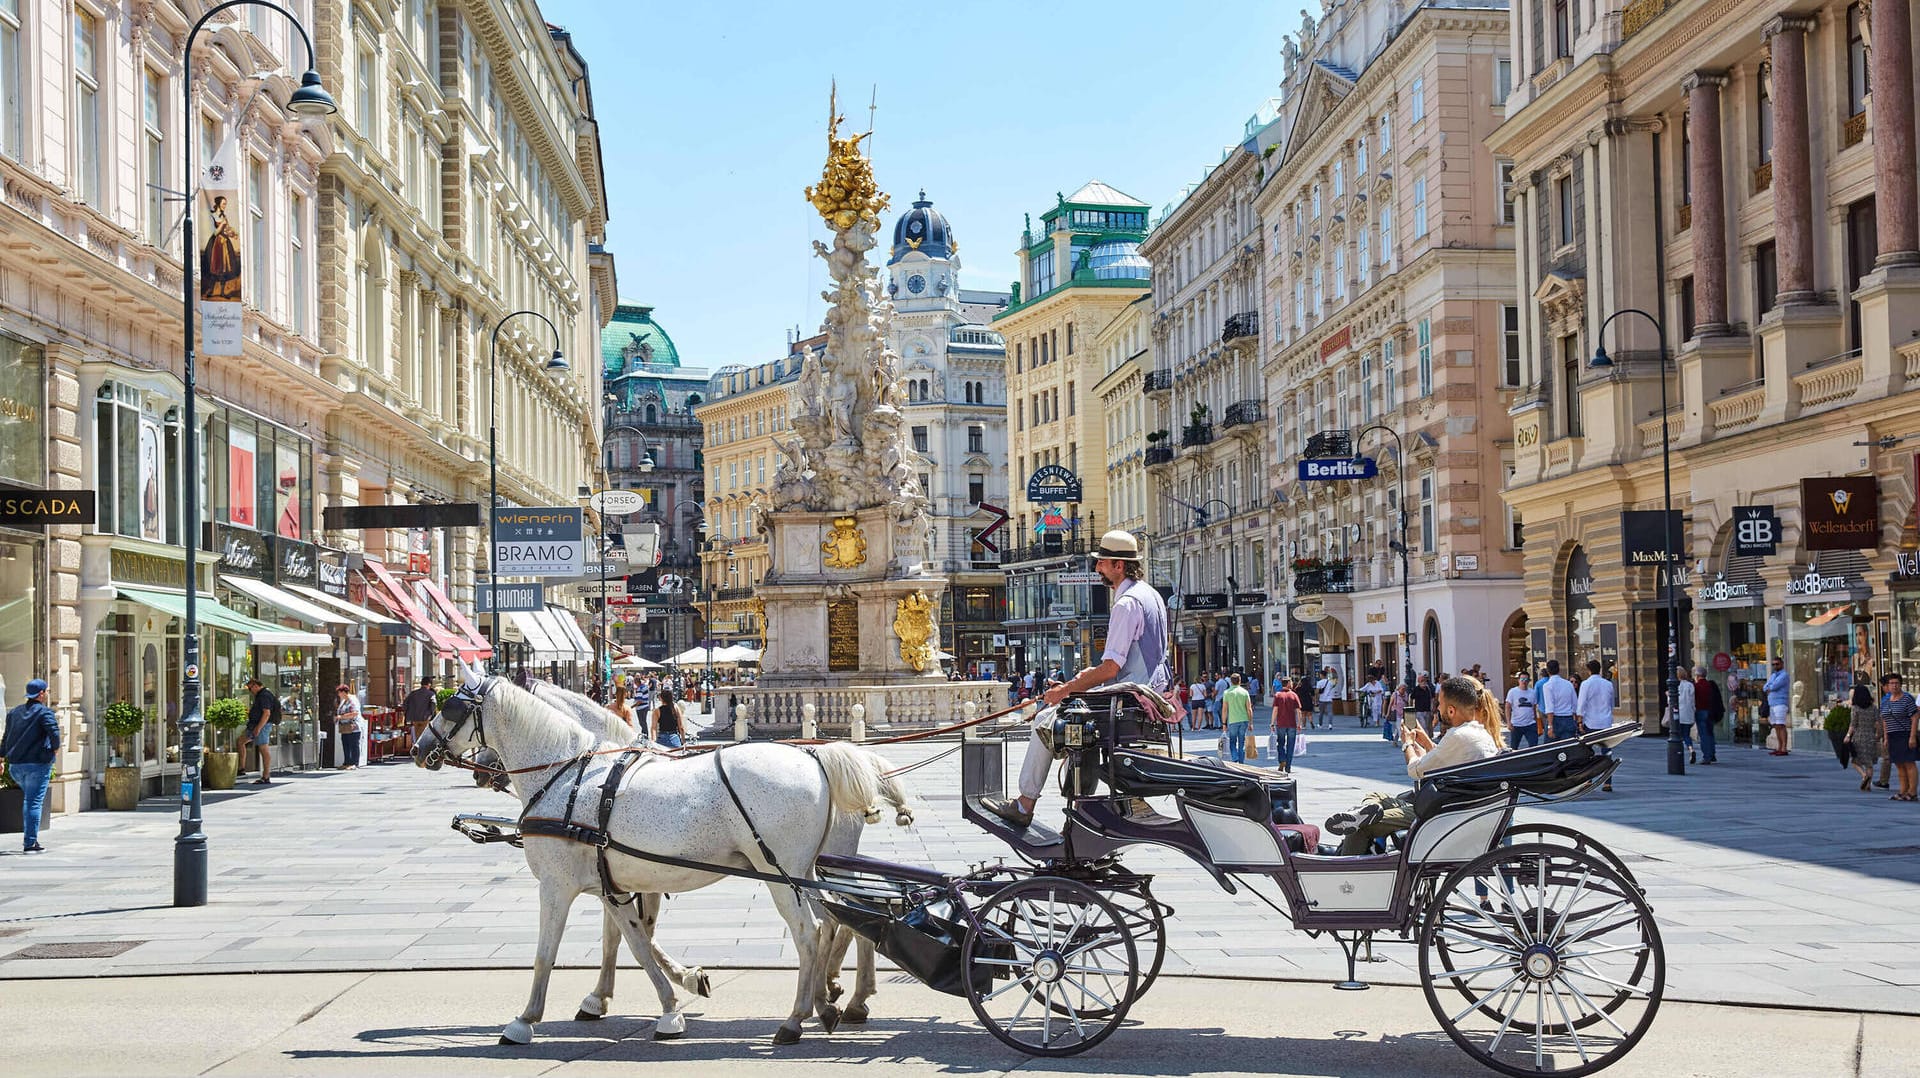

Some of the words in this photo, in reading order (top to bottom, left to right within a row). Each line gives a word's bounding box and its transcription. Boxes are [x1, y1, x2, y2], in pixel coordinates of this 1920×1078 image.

[0, 499, 81, 515] SCADA
[498, 514, 573, 524] wienerin
[1808, 520, 1876, 534] Wellendorff
[498, 546, 573, 561] BRAMO
[486, 589, 534, 608] BAUMAX
